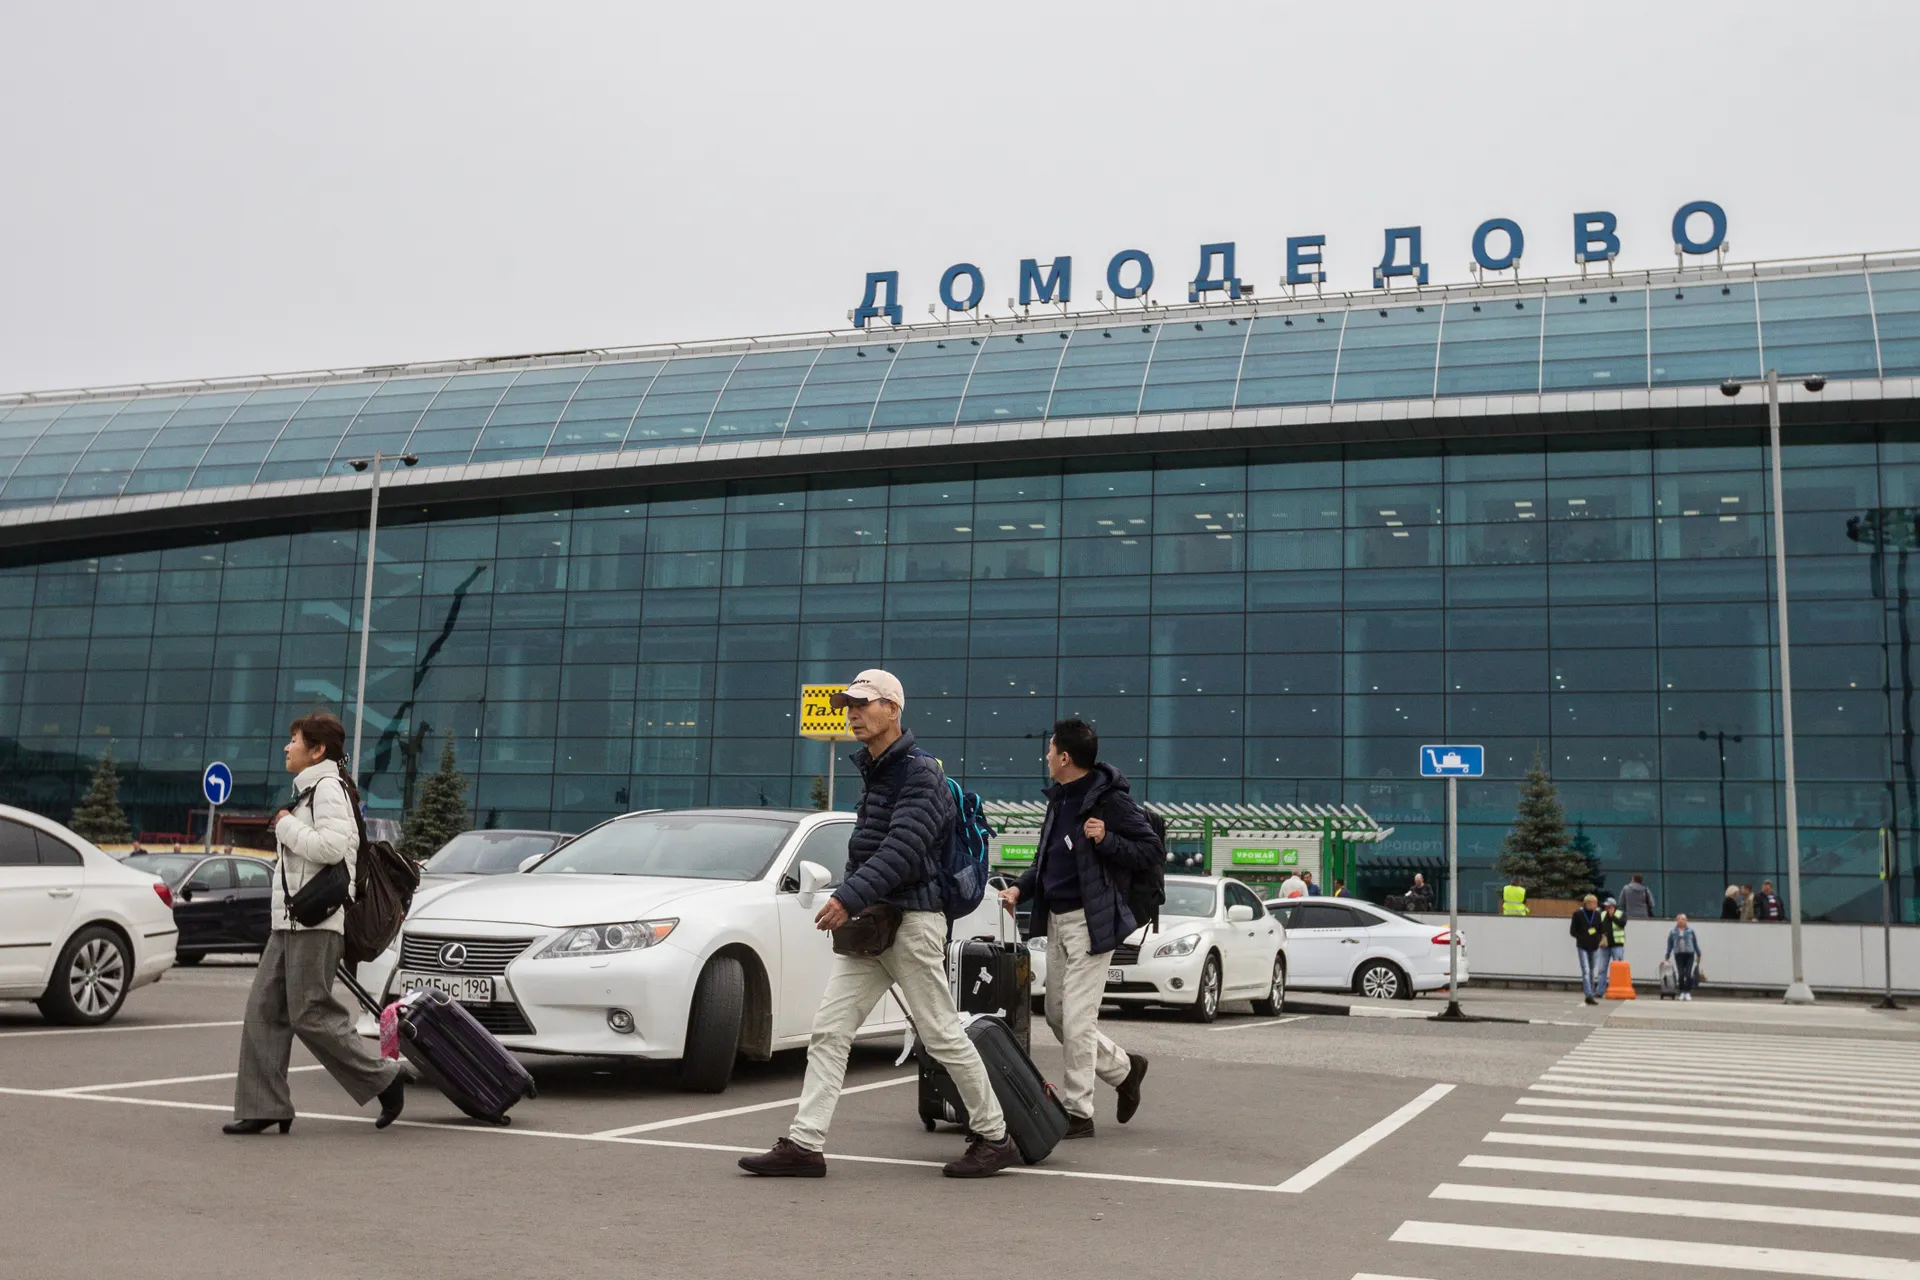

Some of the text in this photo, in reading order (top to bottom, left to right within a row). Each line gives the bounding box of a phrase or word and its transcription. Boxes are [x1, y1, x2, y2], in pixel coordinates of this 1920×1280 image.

[854, 201, 1728, 328] ДОМОДЕДОВО
[1236, 851, 1275, 859] УРОЖАЙ
[464, 979, 487, 994] 190
